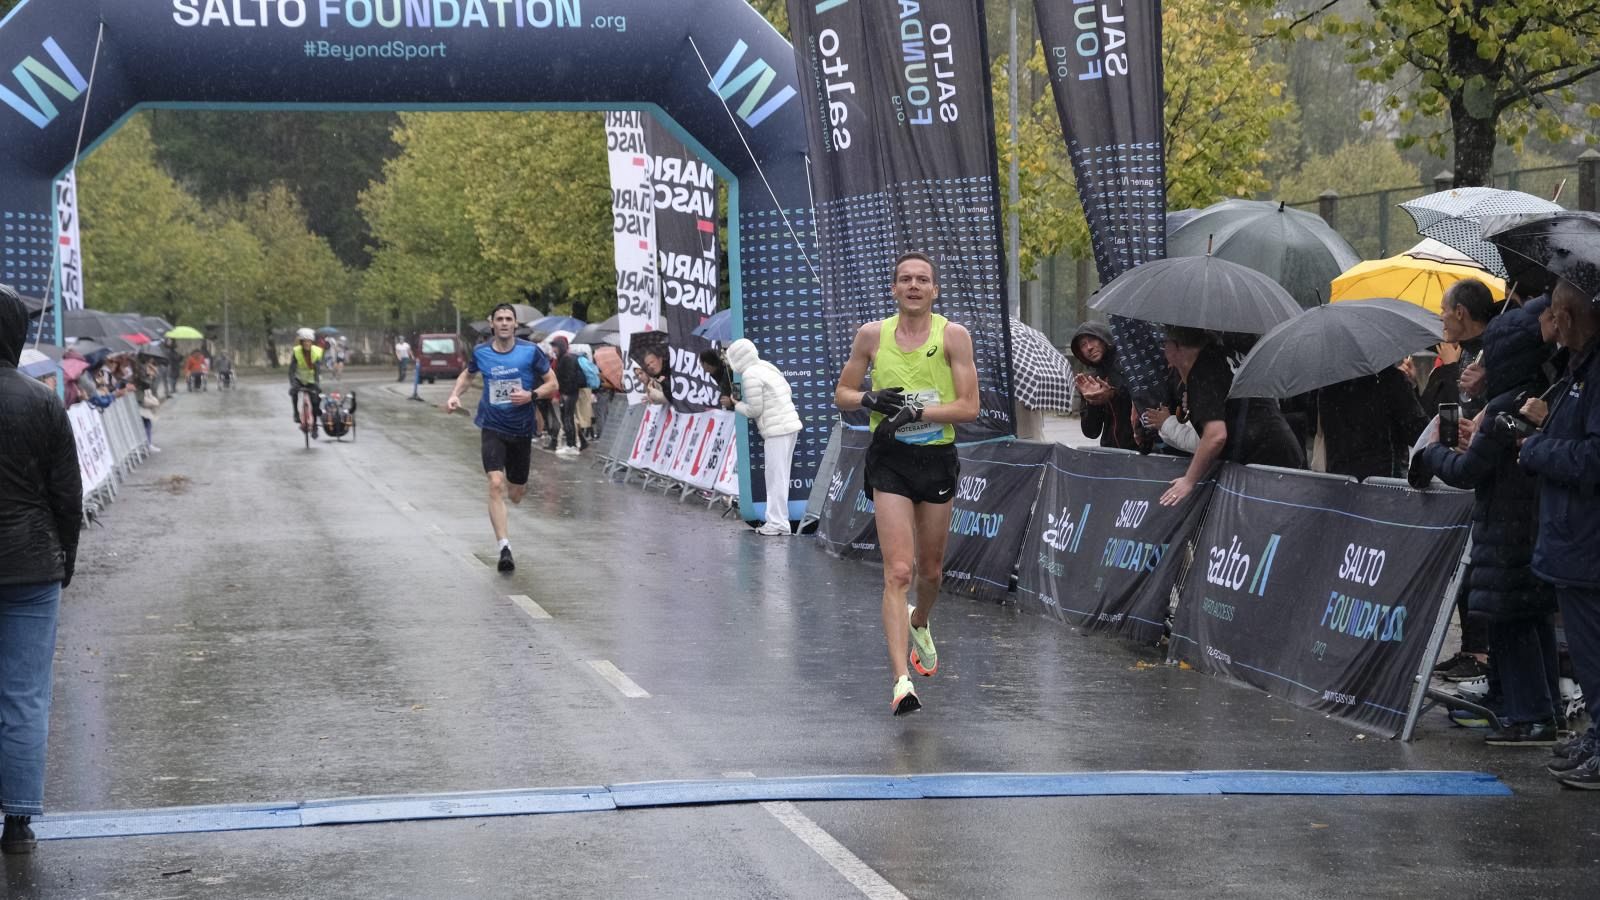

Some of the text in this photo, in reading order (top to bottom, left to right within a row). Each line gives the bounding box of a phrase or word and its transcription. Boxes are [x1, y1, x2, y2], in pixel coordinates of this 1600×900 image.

[172, 0, 627, 32] SALTO FOUNDATION .org
[303, 40, 447, 61] #BeyondSport
[956, 477, 987, 502] SALTO
[1115, 499, 1149, 529] SALTO
[1338, 542, 1386, 587] SALTO
